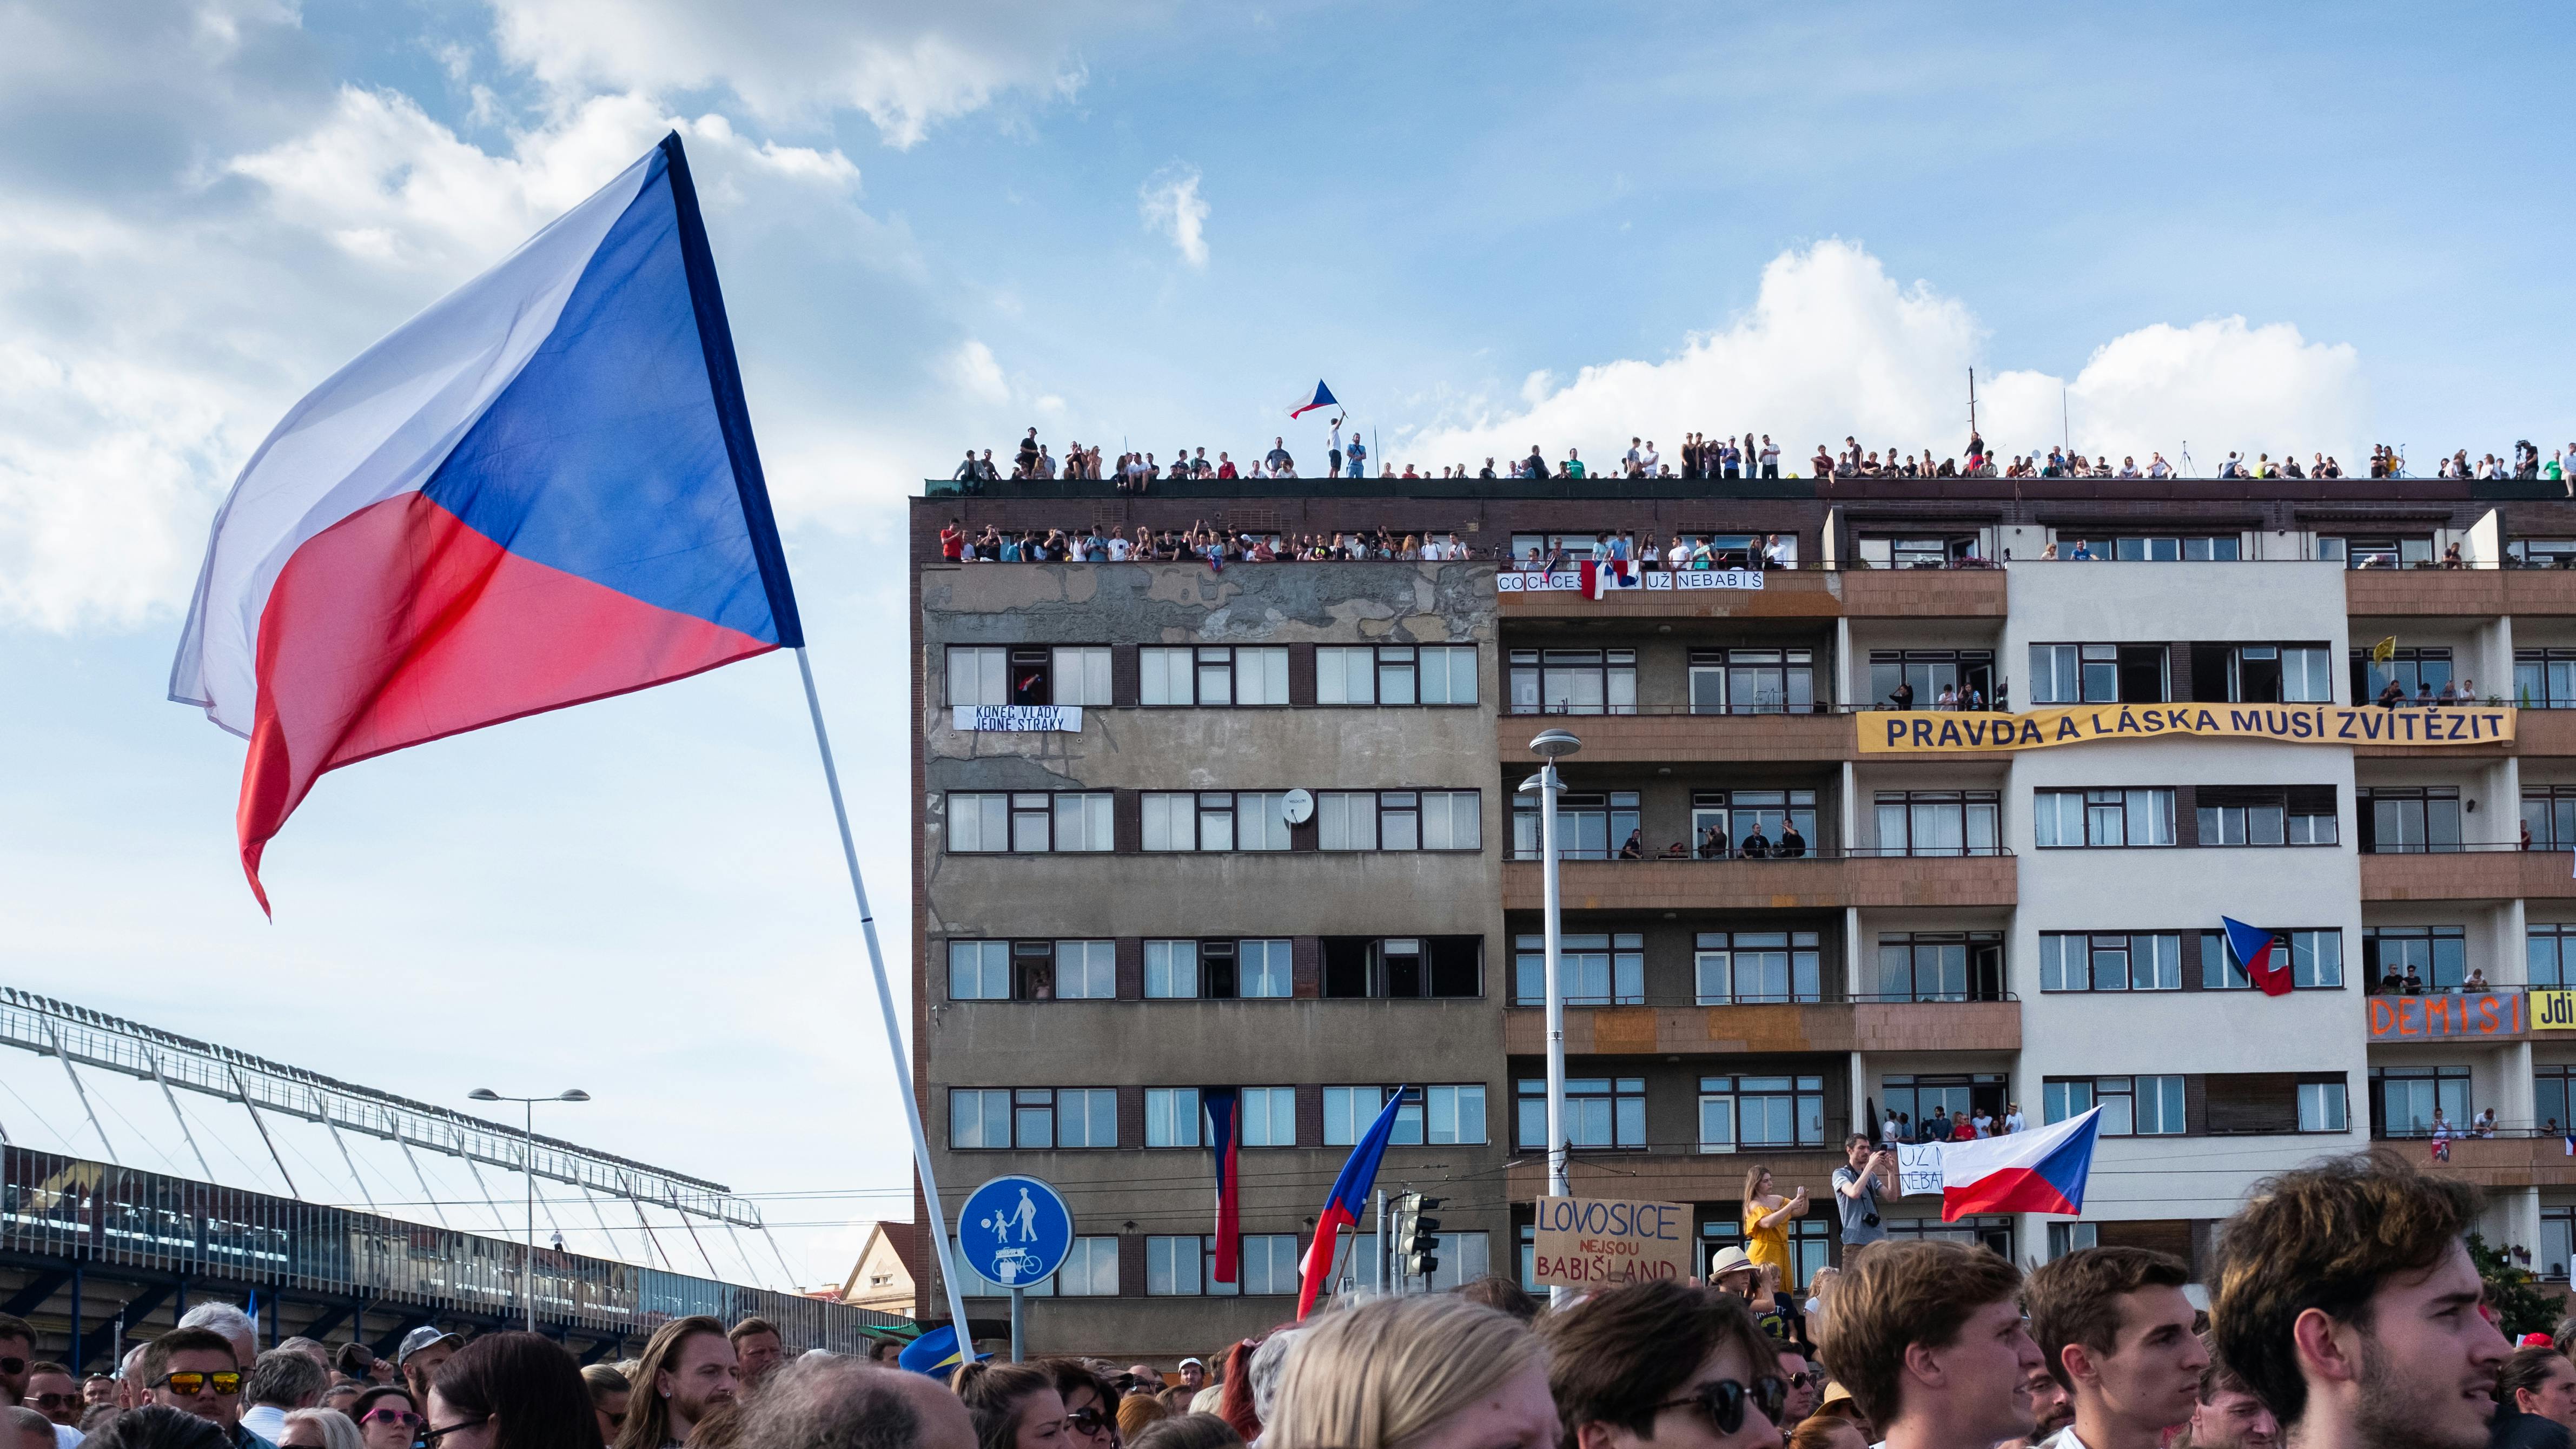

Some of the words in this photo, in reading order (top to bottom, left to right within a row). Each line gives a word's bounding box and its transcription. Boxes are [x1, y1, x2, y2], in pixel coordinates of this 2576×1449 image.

[1499, 577, 1524, 590] CO
[1648, 573, 1670, 587] UŽ
[974, 717, 1016, 731] JEDNÉ
[1018, 718, 1063, 730] STRAKY
[976, 705, 1015, 718] KONEC
[1022, 705, 1059, 718] VLÁDY
[1886, 719, 2043, 747] PRAVDA
[2056, 716, 2082, 741] A
[2092, 705, 2221, 735] LÁSKA
[2230, 707, 2325, 738] MUSÍ
[2337, 706, 2505, 740] ZVÍTĚZIT
[2370, 995, 2519, 1035] DEMISI
[2541, 992, 2573, 1024] Jdi
[1901, 1170, 1943, 1192] NEBA
[1540, 1200, 1680, 1240] LOVOSICE
[1580, 1239, 1639, 1256] NEJSOU
[1537, 1255, 1676, 1283] BABIŠLAND
